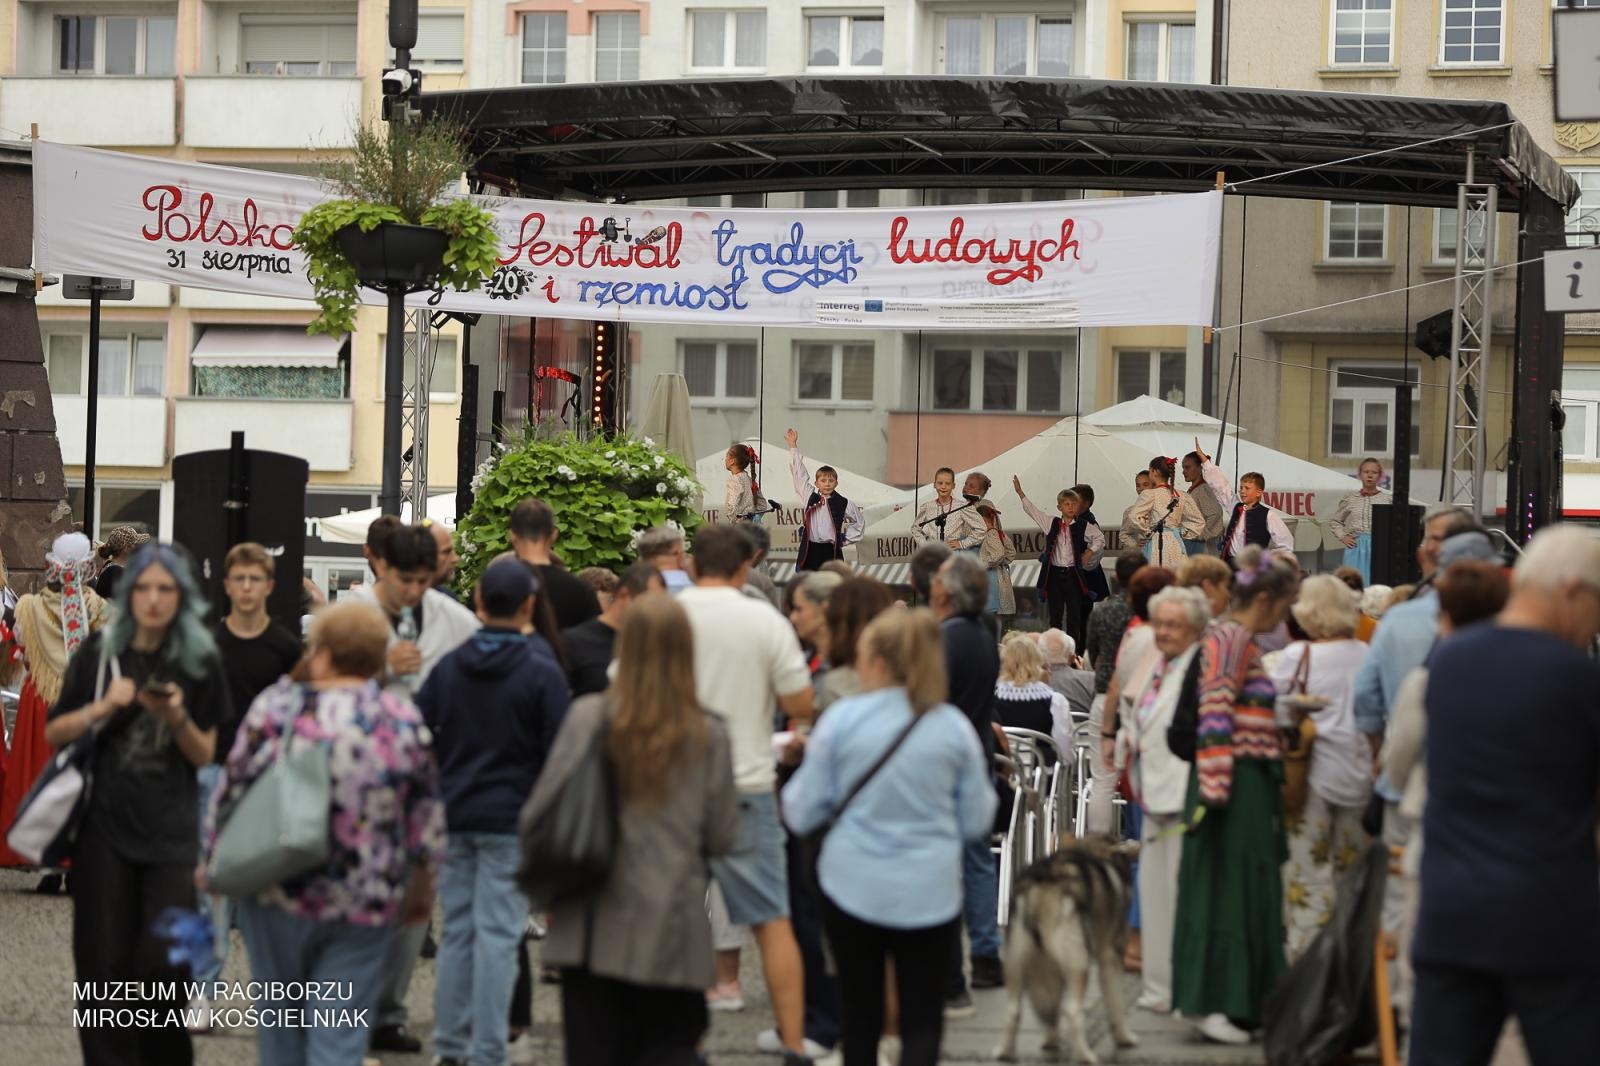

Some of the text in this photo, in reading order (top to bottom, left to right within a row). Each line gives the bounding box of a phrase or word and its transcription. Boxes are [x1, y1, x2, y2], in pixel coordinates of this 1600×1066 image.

[166, 248, 186, 269] 31
[202, 249, 292, 279] sierpnia
[712, 219, 864, 294] tradycji
[887, 216, 1081, 284] ludowych
[540, 264, 750, 311] i rzemiosł
[819, 302, 861, 311] Interreg
[1262, 491, 1316, 516] WIEC
